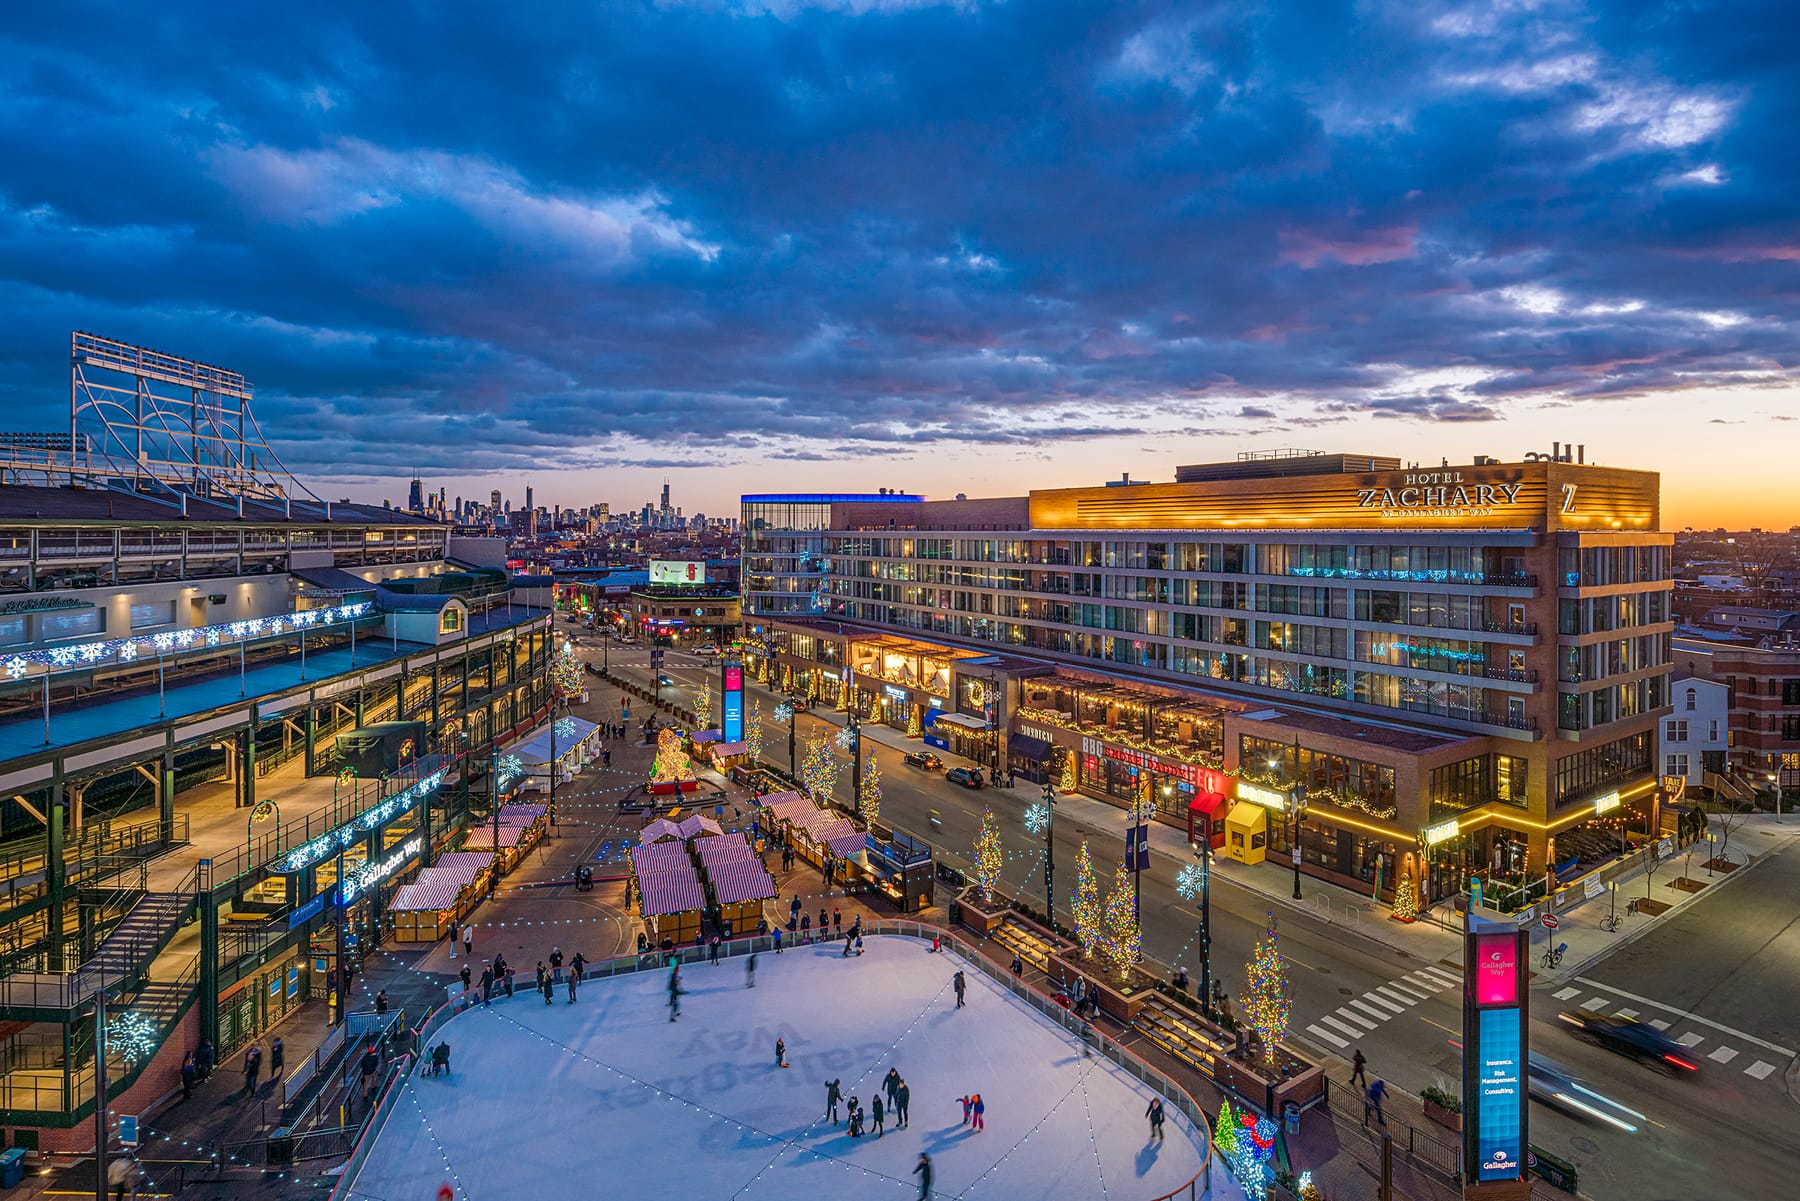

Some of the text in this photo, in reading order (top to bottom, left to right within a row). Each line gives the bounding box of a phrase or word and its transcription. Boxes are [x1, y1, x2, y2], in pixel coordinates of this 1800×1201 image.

[1404, 472, 1464, 485] HOTEL
[1357, 483, 1523, 508] ZACHARY
[1561, 483, 1578, 514] Z
[1398, 508, 1463, 517] GALLAGHER
[1469, 508, 1493, 516] WAY
[1082, 736, 1103, 758] BBQ
[1105, 746, 1188, 780] SMOKE DADDY
[360, 837, 422, 888] Gallagher Way
[1481, 961, 1514, 969] Gallagher
[1483, 1160, 1517, 1170] Gallagher
